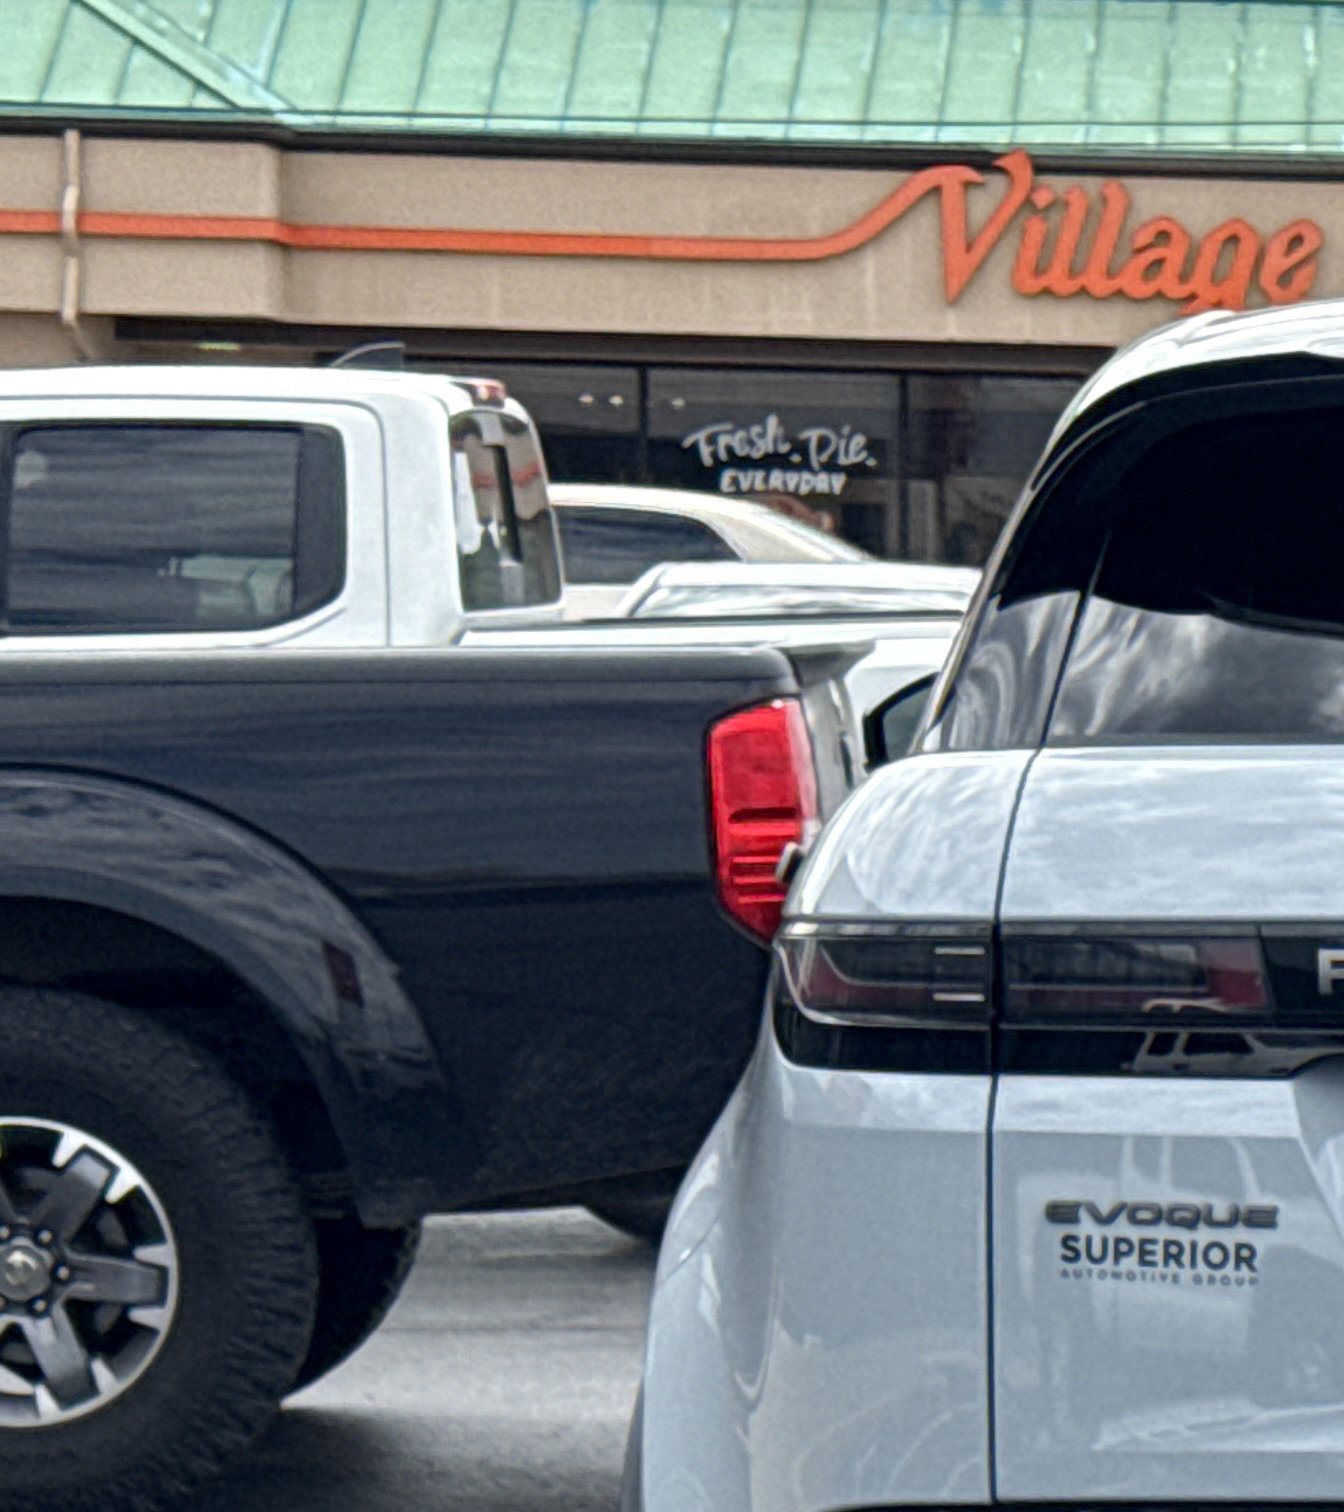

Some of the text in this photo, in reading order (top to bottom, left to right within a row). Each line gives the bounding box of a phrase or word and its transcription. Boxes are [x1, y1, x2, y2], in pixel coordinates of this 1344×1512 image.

[928, 148, 1323, 315] Village
[720, 469, 848, 496] EVERYDAY
[1044, 1199, 1279, 1231] EVOQUE
[1059, 1234, 1260, 1272] SUPERIOR
[1058, 1268, 1260, 1288] AUTOMOTIVE GROUP
